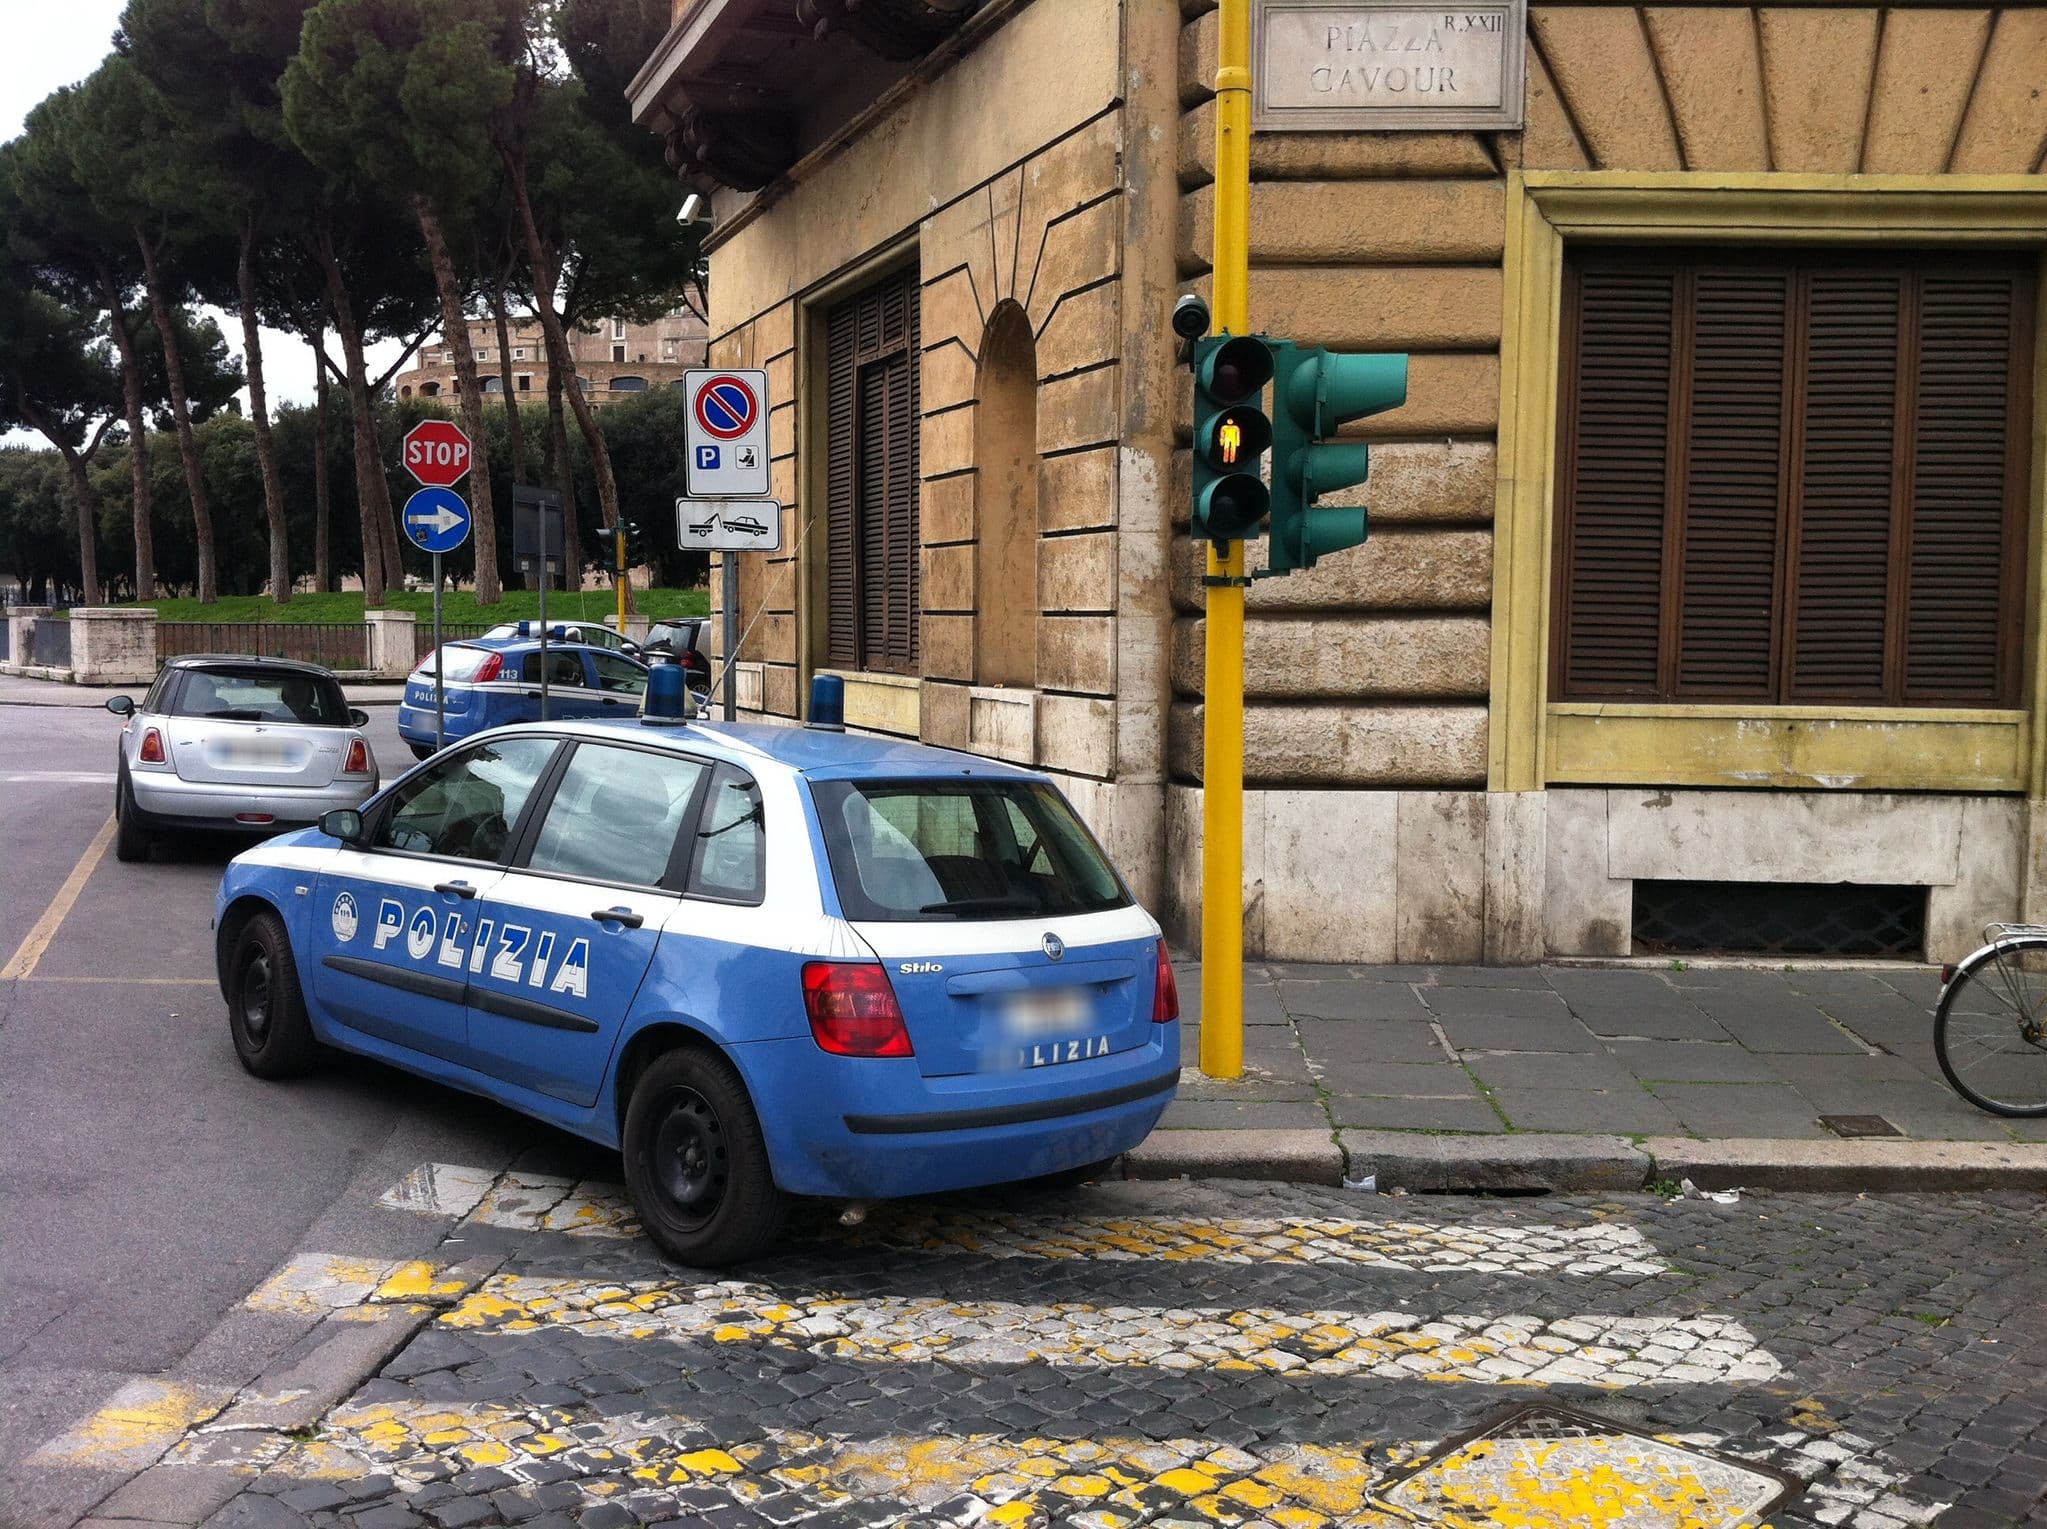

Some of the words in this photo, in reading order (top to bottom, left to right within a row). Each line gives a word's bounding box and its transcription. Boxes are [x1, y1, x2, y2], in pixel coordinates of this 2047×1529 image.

[1327, 25, 1443, 51] PIAZZA
[1310, 66, 1457, 93] CAVOUR
[408, 440, 468, 466] STOP
[701, 448, 716, 467] P
[498, 669, 518, 679] 113
[414, 690, 448, 704] POLIZA
[373, 898, 590, 998] POLIZIA
[899, 961, 943, 974] Stilo
[1018, 1035, 1109, 1067] LIZIA
